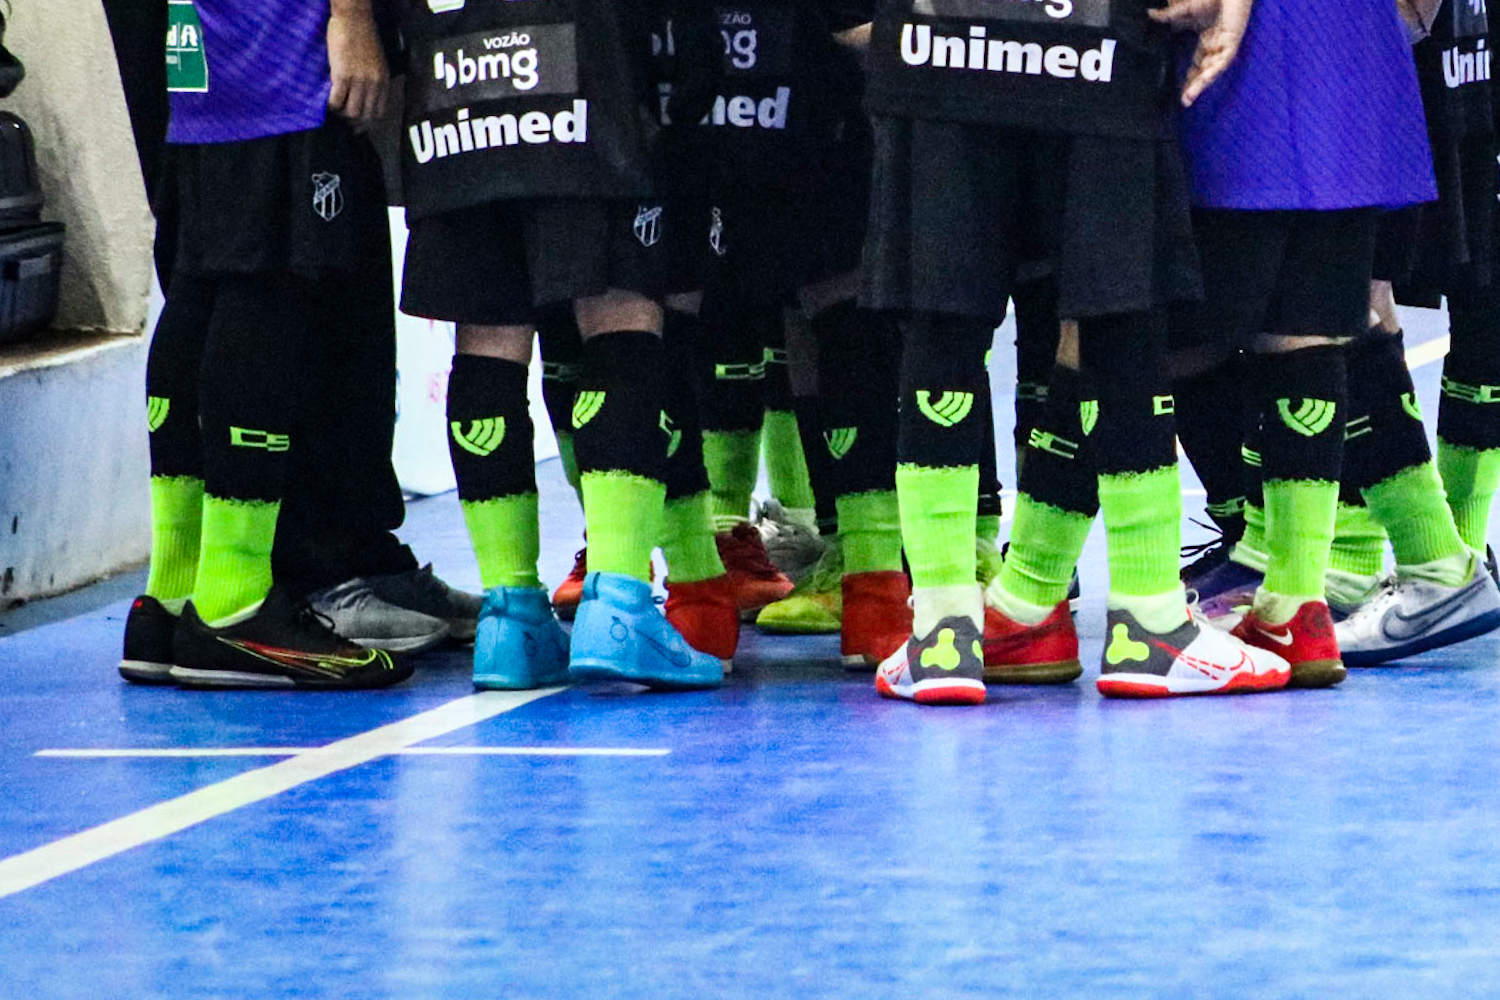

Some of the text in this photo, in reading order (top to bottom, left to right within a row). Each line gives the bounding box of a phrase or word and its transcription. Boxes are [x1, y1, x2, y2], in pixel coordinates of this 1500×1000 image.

[483, 32, 531, 49] VOZÃO
[722, 13, 752, 25] ZÃO
[457, 48, 539, 91] bmg
[900, 23, 1117, 82] Unimed
[1442, 38, 1491, 88] Uni
[409, 99, 587, 164] Unimed
